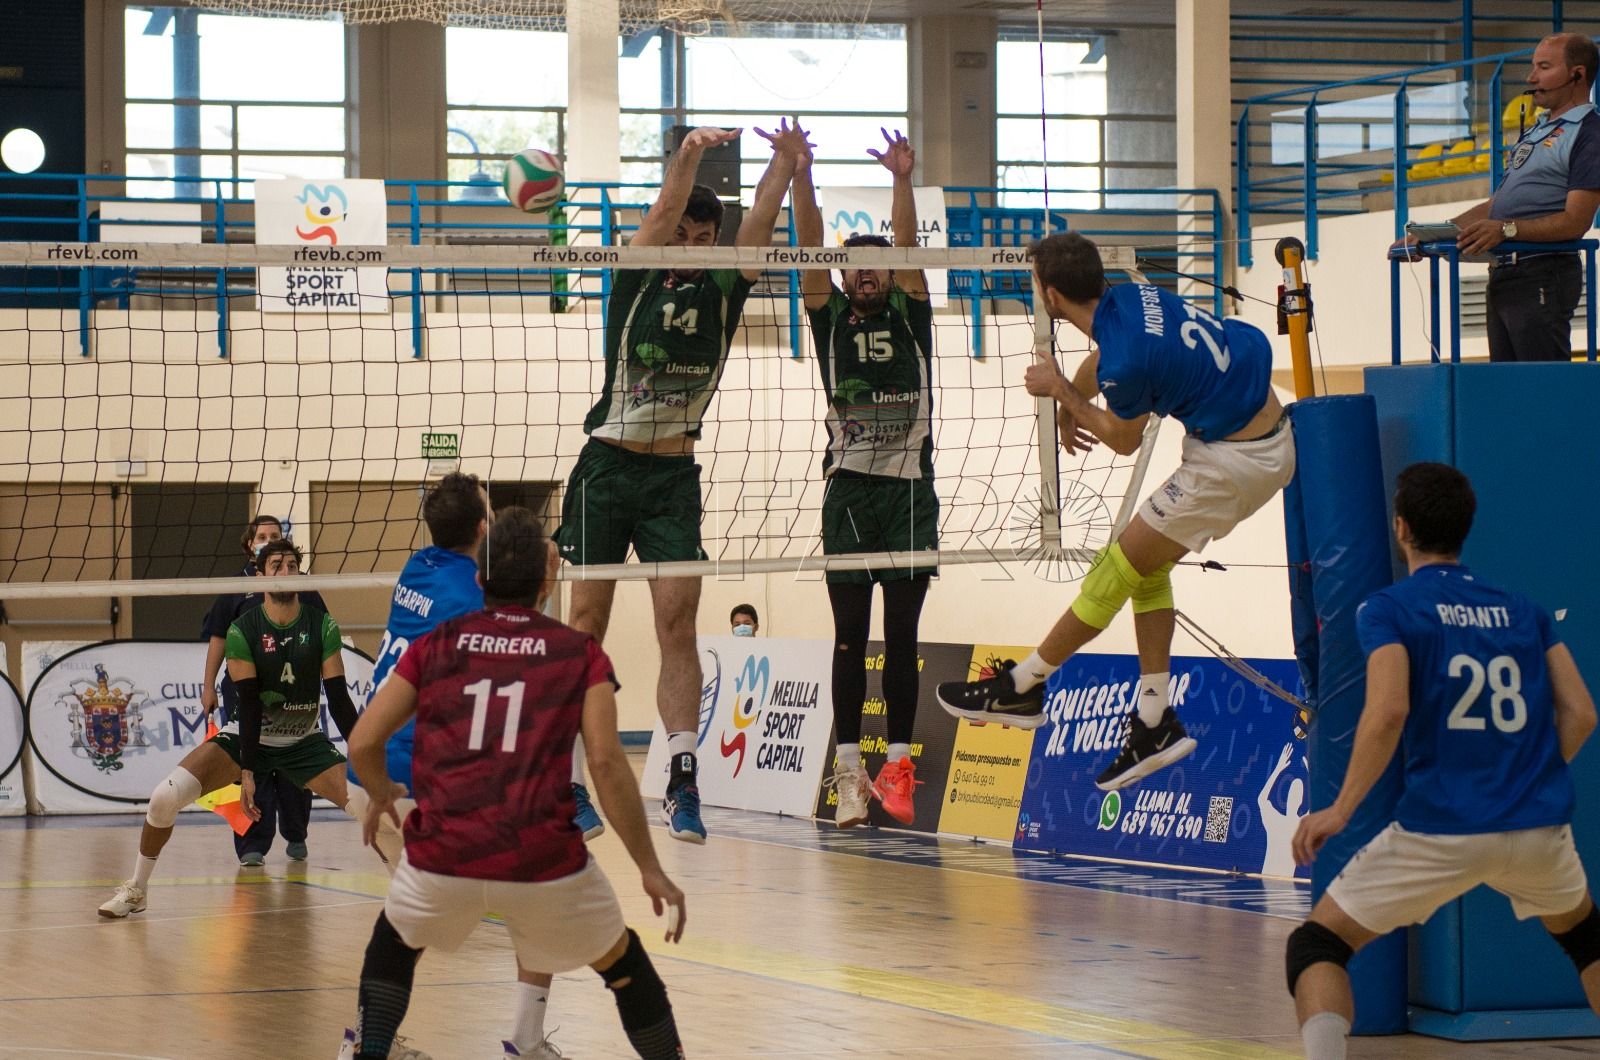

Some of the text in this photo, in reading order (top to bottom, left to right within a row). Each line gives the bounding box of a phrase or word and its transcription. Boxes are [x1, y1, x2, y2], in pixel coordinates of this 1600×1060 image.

[47, 244, 138, 260] rfevb.com
[294, 246, 382, 262] rfevb.com
[533, 247, 619, 262] rfevb.com
[766, 248, 849, 263] rfevb.com
[286, 275, 344, 289] SPORT
[285, 292, 358, 307] CAPITAL
[662, 302, 699, 335] 14
[853, 330, 894, 363] 15
[665, 362, 711, 377] Unicaja
[872, 390, 921, 405] Unicaja
[422, 435, 457, 447] SALIDA
[394, 583, 434, 618] SCARPIN
[1436, 603, 1510, 629] RIGANTI
[456, 633, 547, 656] FERRERA
[280, 661, 296, 685] 4
[768, 680, 820, 709] MELILLA
[1446, 654, 1528, 733] 28
[184, 706, 198, 716] DE
[283, 701, 317, 712] Unicaja
[463, 678, 526, 753] 11
[762, 710, 806, 740] SPORT
[1044, 722, 1070, 757] AL
[756, 742, 805, 773] CAPITAL
[1135, 789, 1192, 815] LLAMA AL
[1121, 811, 1203, 840] 689 967 690
